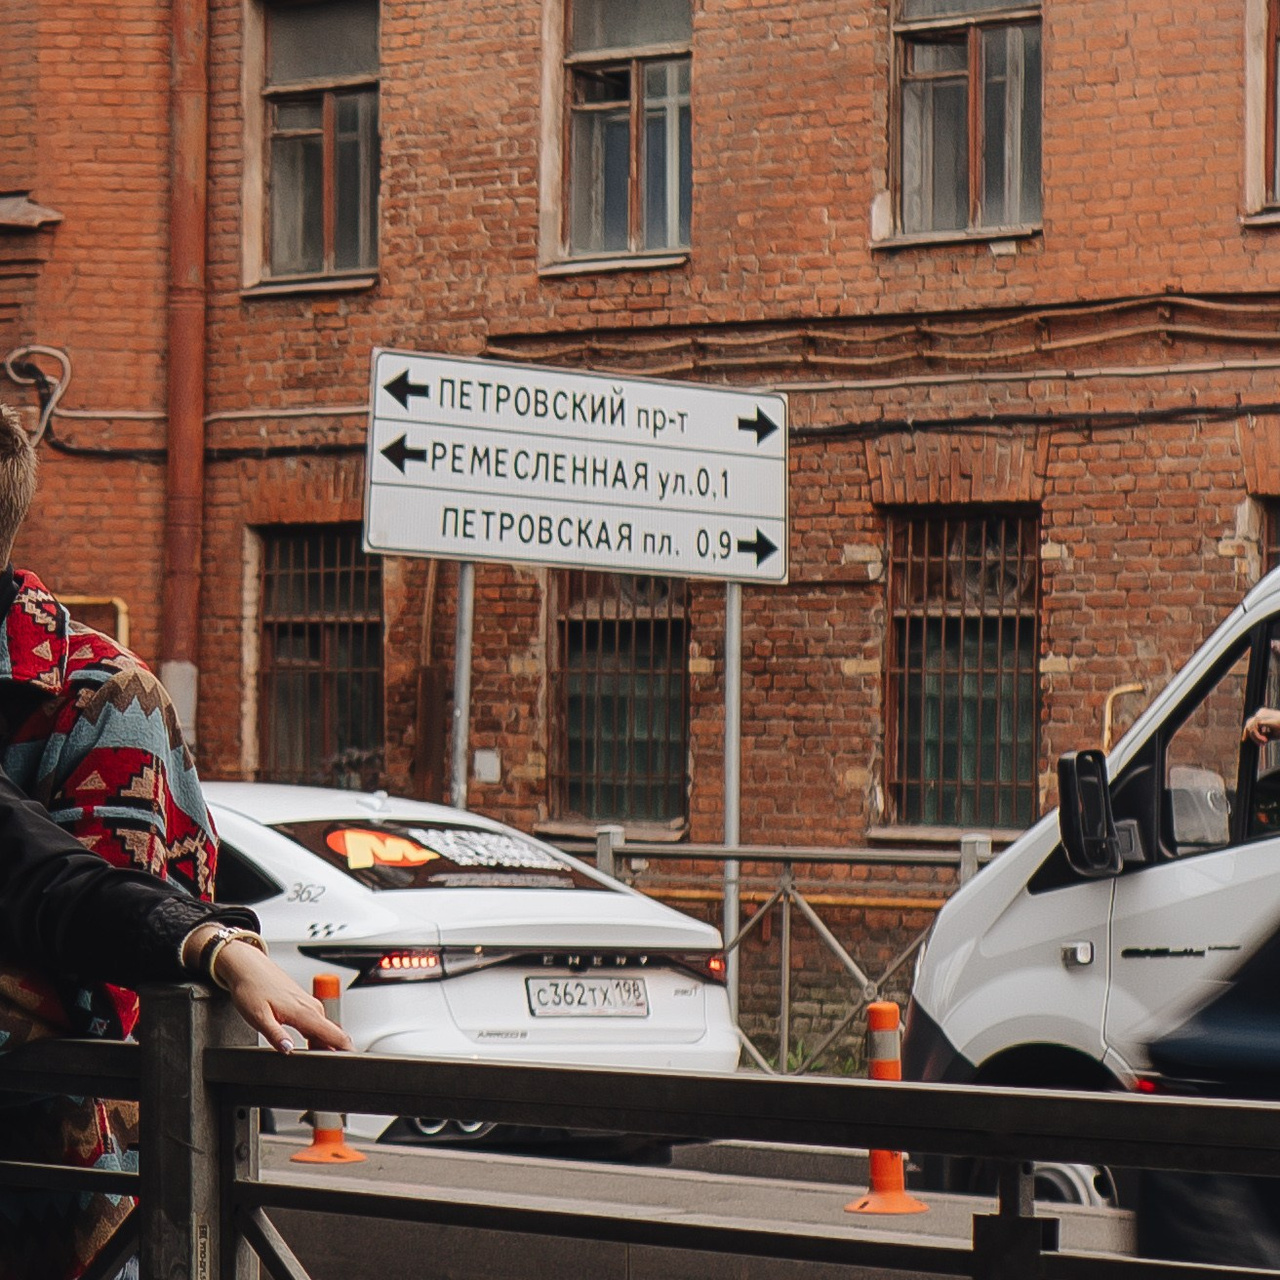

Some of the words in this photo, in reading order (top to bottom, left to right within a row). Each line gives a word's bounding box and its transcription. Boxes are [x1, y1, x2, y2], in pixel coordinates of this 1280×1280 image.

[439, 377, 626, 427] ПЕТРОВСКИЙ
[637, 406, 689, 438] пр-т
[431, 441, 649, 491] РЕМЕСЛЕННАЯ
[442, 506, 632, 552] ПЕТРОВСКАЯ
[643, 533, 680, 557] пл.
[697, 528, 732, 563] 0,9
[287, 882, 326, 902] 362
